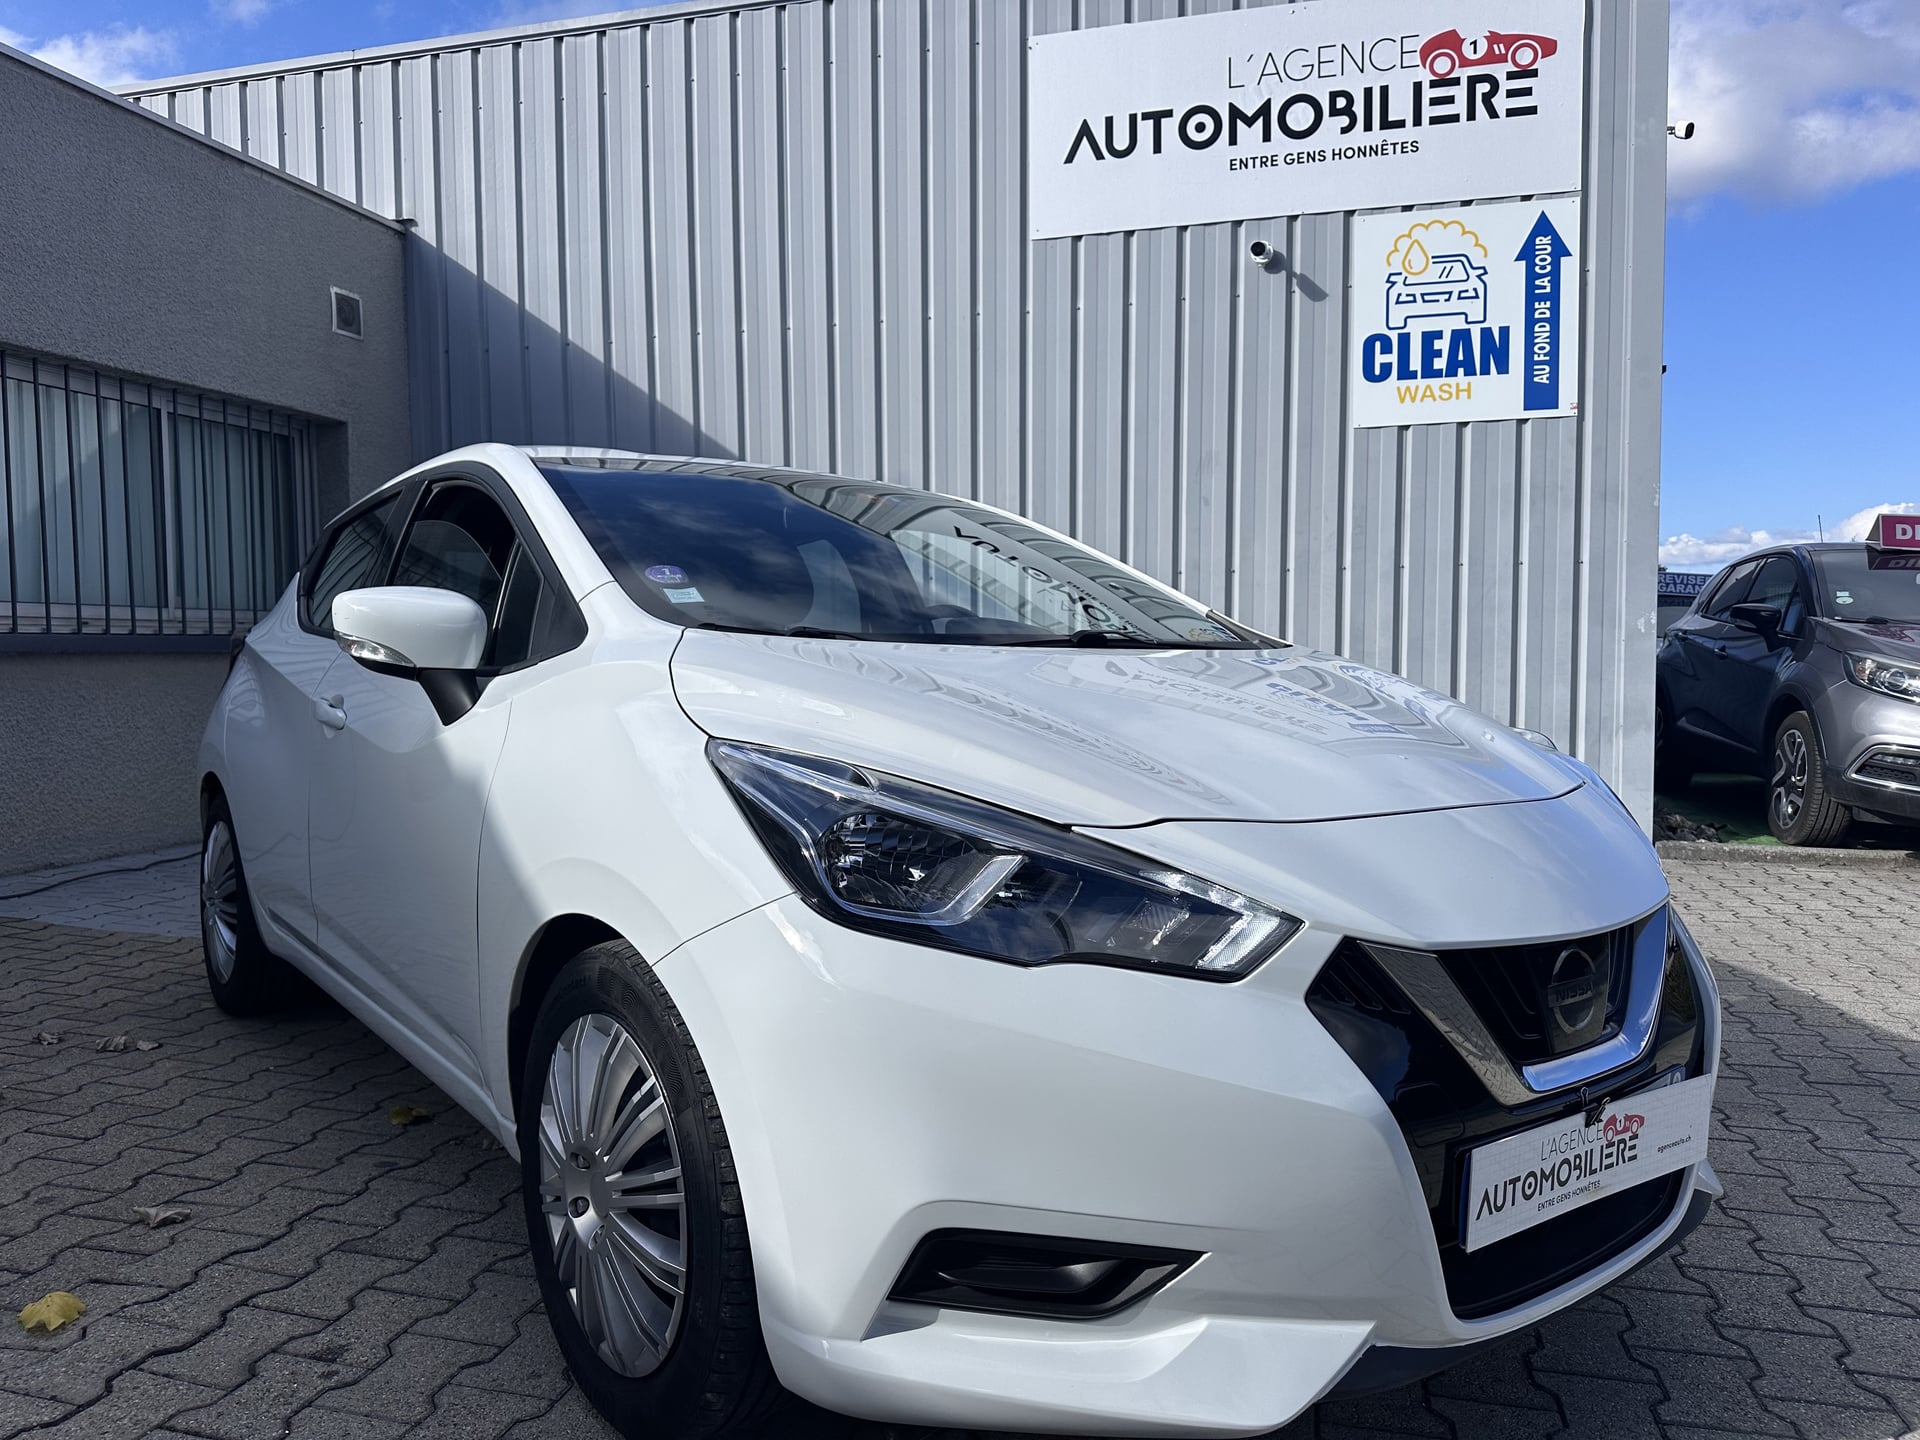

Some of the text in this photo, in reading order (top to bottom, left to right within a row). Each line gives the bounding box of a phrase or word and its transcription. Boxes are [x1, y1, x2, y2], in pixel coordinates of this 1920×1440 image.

[1228, 34, 1420, 89] L'AGENCE
[1469, 39, 1479, 55] 1
[1229, 139, 1420, 171] ENTRE GENS HONNÊTES
[1533, 235, 1552, 384] AU FOND DE LA COUR
[1362, 325, 1511, 383] CLEAN
[1396, 381, 1472, 404] WASH
[1537, 1198, 1556, 1212] ENTRE
[1556, 1191, 1572, 1205] GENS
